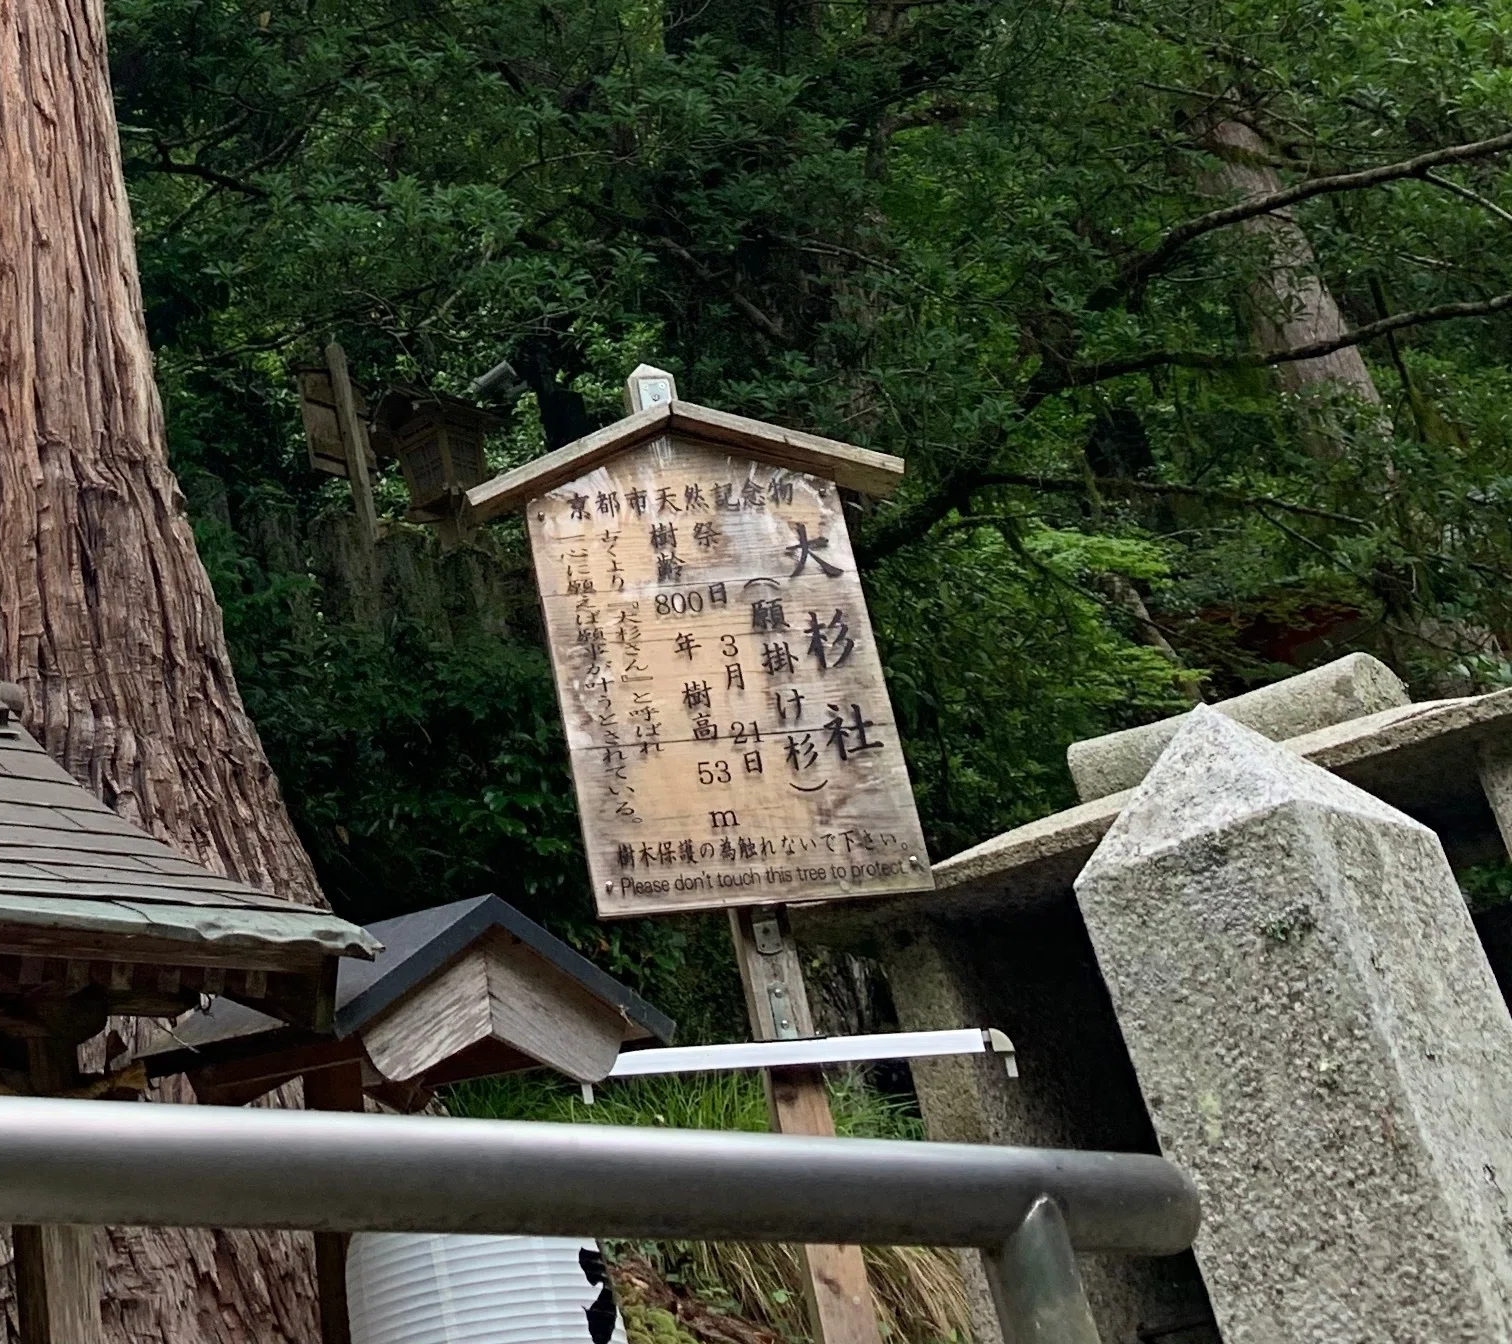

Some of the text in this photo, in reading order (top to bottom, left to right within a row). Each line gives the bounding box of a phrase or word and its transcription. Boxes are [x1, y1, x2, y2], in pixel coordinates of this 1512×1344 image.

[567, 478, 794, 521] 京都市天然記念物
[620, 875, 670, 896] Please
[674, 870, 714, 892] don't
[717, 867, 761, 888] touch
[766, 865, 793, 884] this
[796, 864, 827, 881] tree
[831, 863, 847, 880] to
